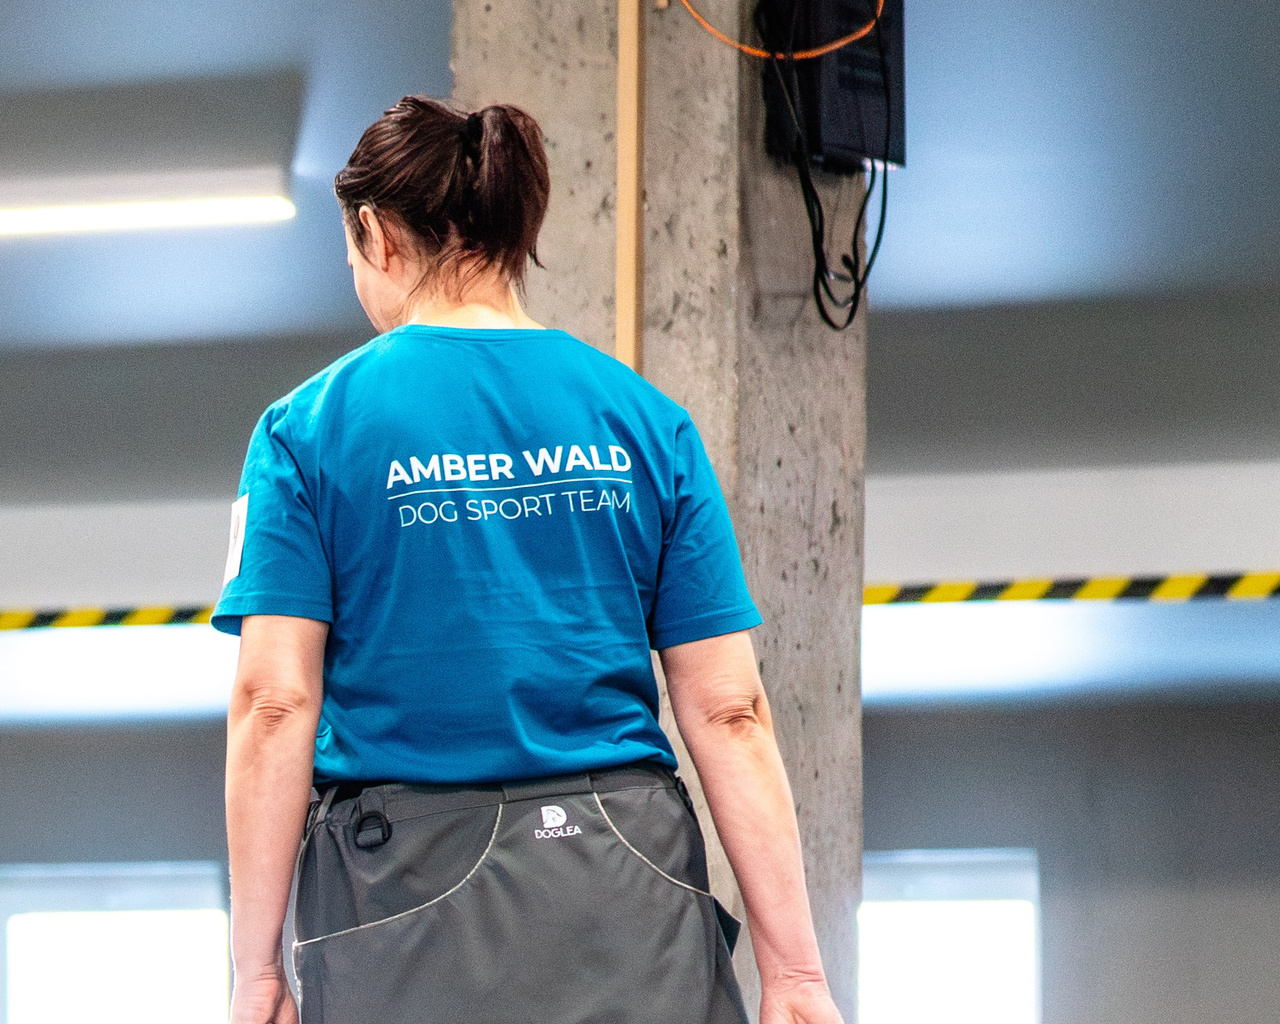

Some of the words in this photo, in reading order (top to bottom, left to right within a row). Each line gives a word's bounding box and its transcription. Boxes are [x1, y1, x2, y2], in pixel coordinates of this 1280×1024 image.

[386, 453, 515, 490] AMBER
[522, 445, 632, 476] WALD
[398, 500, 458, 527] DOG
[466, 493, 556, 520] SPORT
[561, 489, 631, 513] TEAM
[534, 825, 582, 839] DOGLEA
